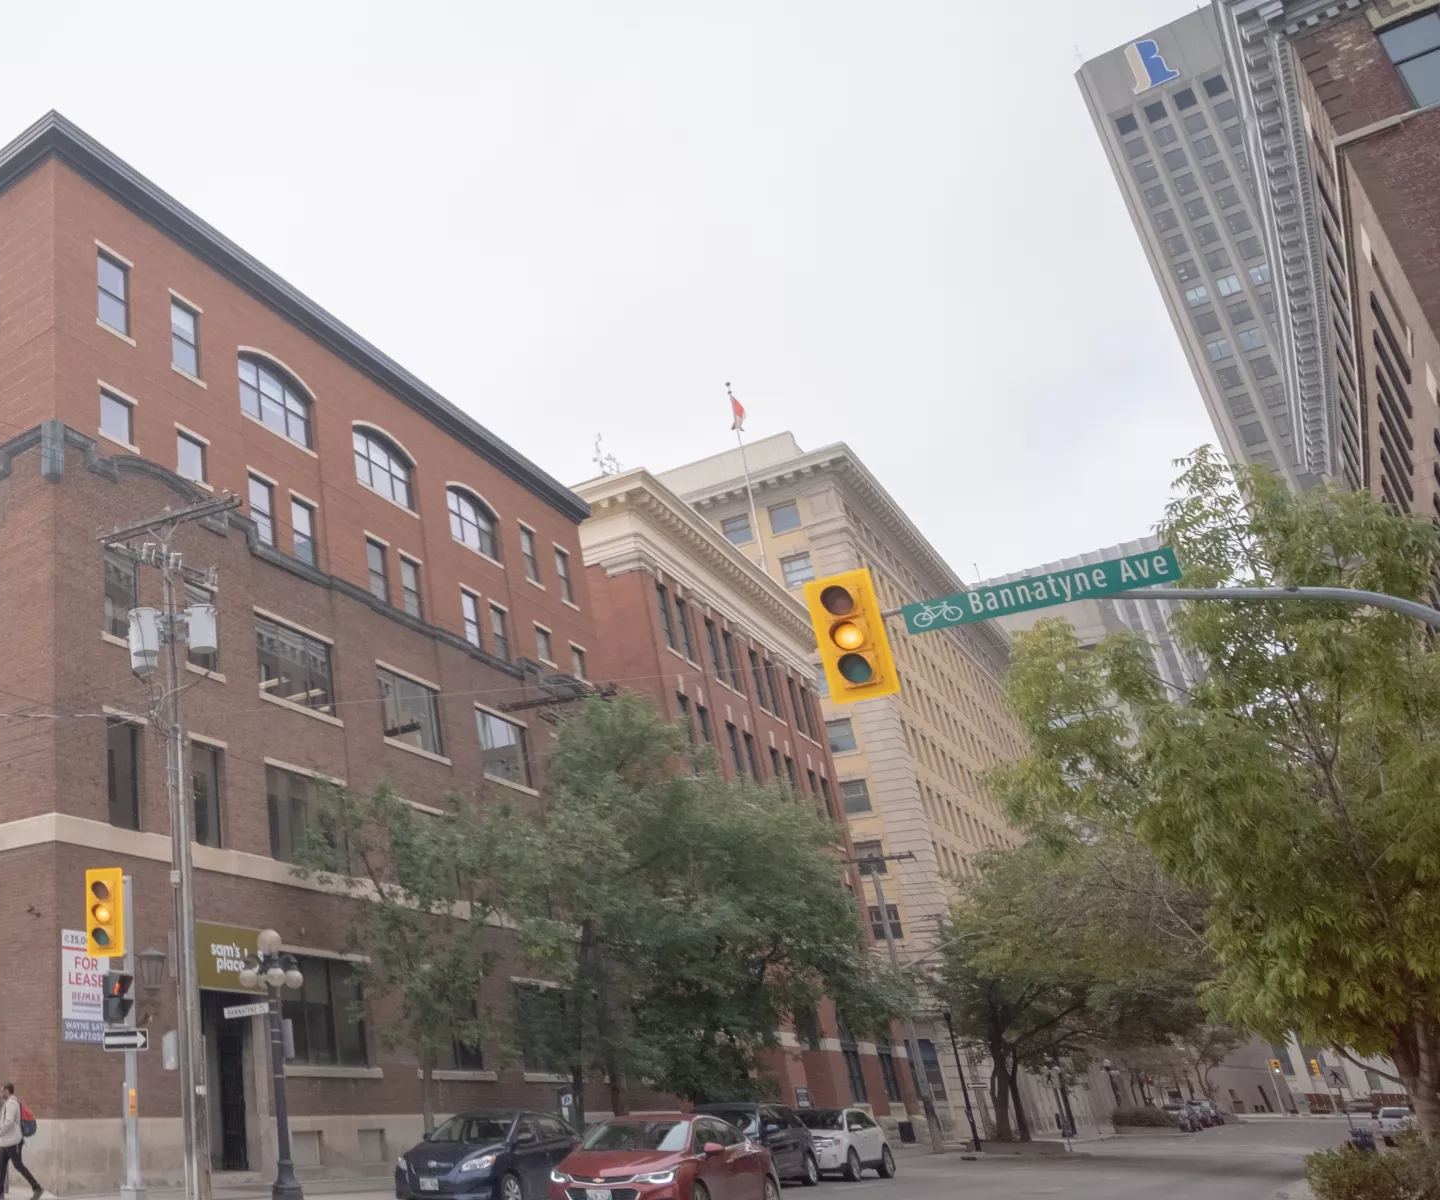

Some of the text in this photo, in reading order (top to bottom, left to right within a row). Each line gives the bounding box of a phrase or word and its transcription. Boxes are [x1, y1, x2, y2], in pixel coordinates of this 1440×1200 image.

[967, 554, 1170, 615] Bannatyne Ave
[70, 935, 88, 945] 35,0
[211, 942, 241, 959] sam's
[74, 956, 99, 971] FOR
[216, 957, 245, 974] place
[68, 971, 104, 988] LEASE
[71, 991, 101, 1003] RE/MAX
[65, 1021, 90, 1030] WAYNE
